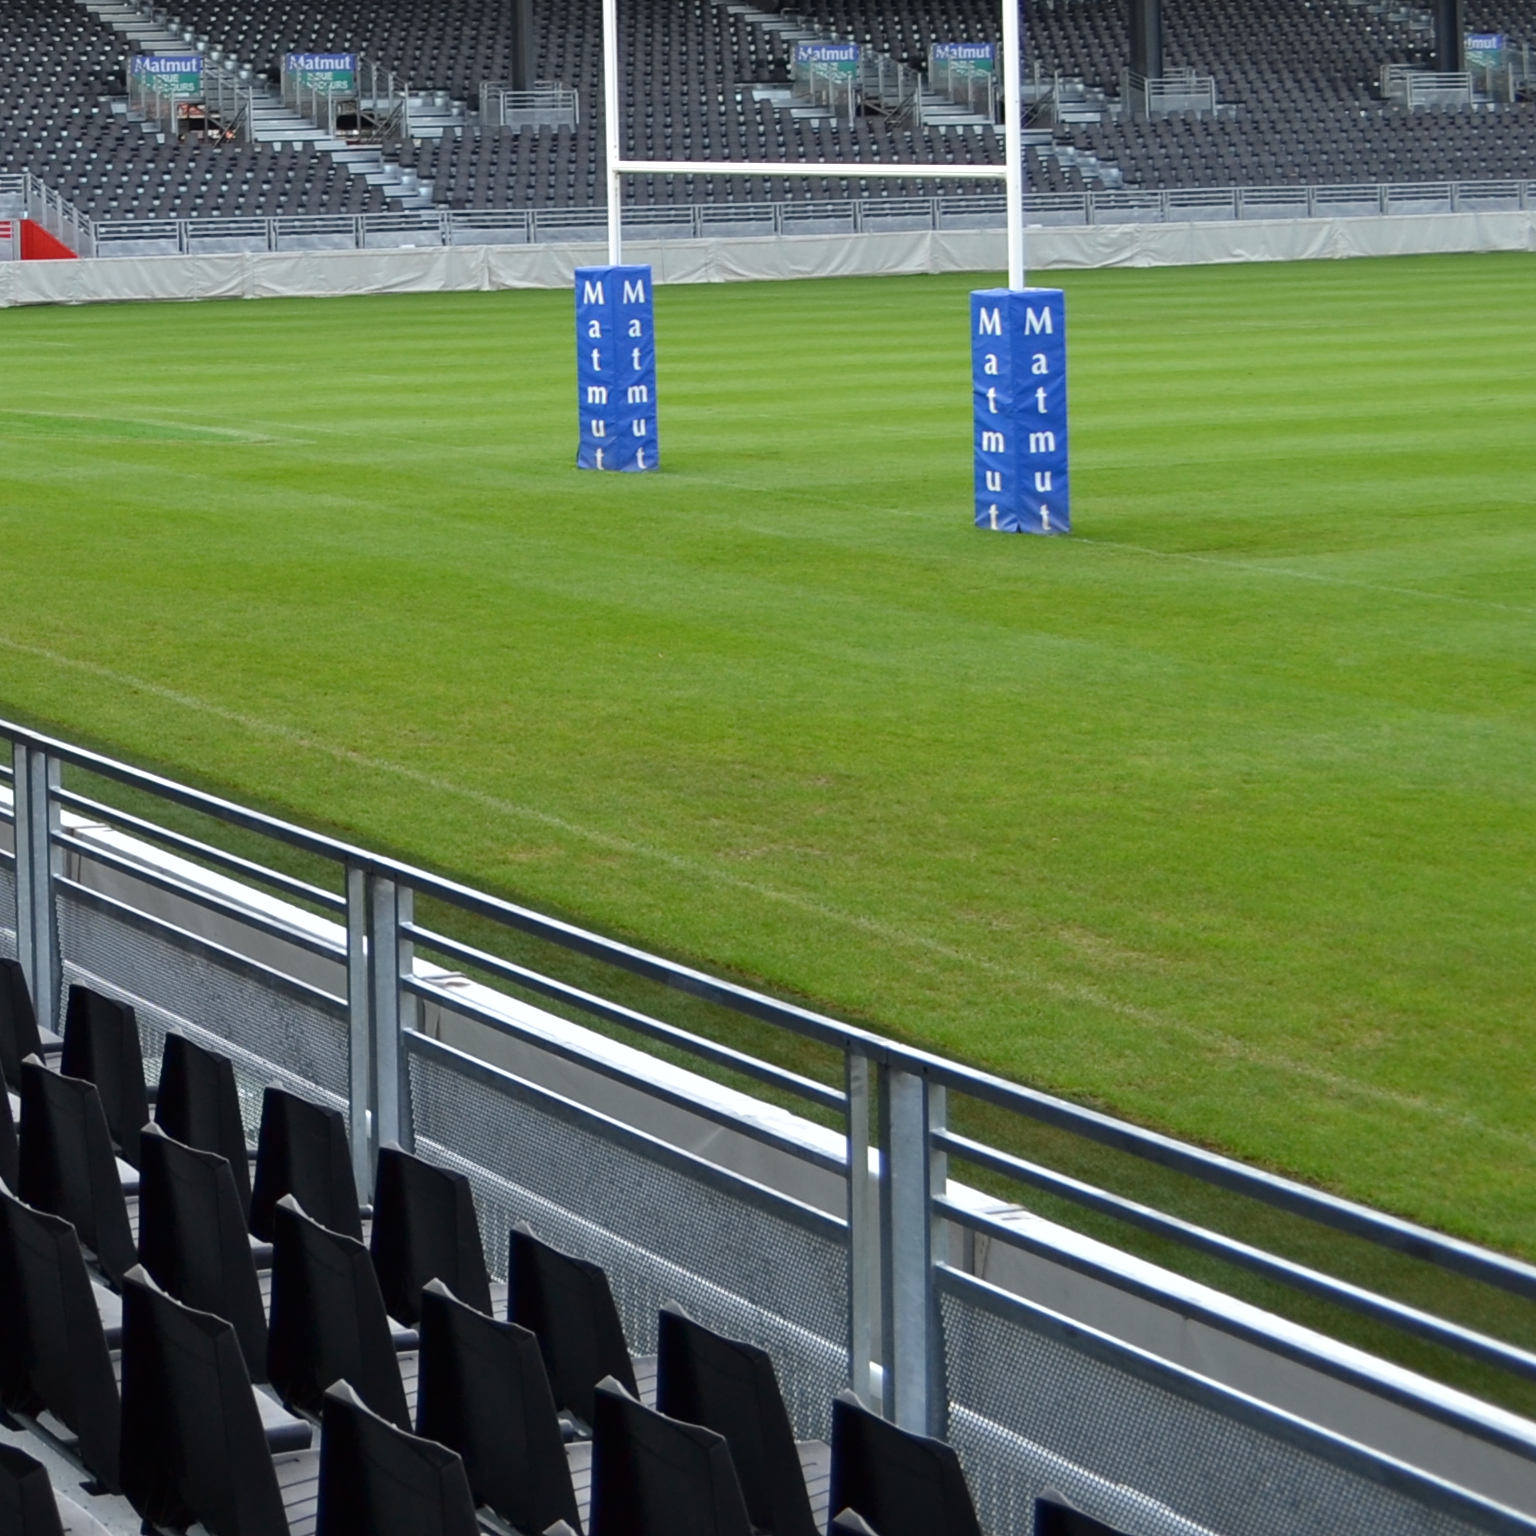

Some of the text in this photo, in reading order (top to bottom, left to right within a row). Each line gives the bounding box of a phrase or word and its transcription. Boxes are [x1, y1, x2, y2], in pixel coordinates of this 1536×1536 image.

[134, 57, 198, 73] Matmut
[289, 55, 351, 70] Matmut
[583, 280, 607, 471] Matmut
[622, 279, 648, 470] Matmut
[979, 307, 1005, 532] Matmut
[1023, 306, 1056, 531] Matmut
